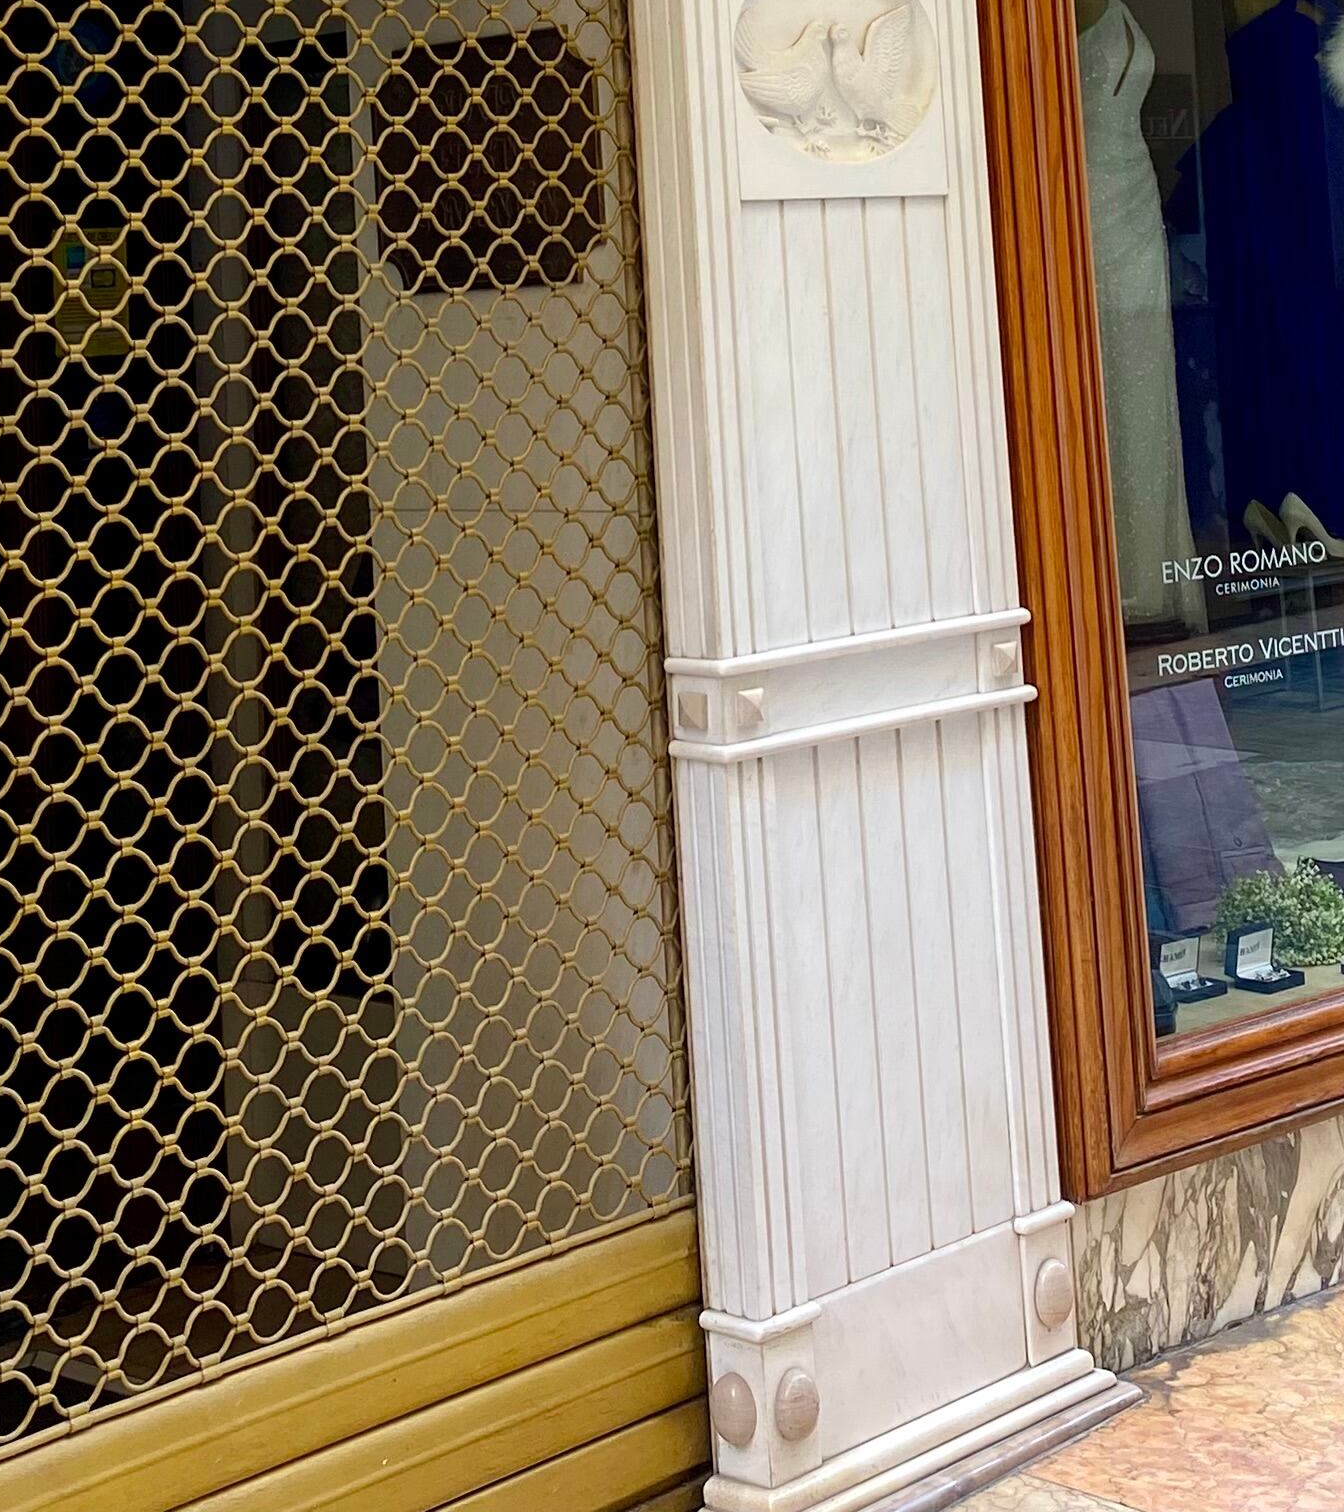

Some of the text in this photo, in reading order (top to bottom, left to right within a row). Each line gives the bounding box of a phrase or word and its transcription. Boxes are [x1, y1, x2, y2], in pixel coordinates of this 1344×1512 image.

[1161, 540, 1327, 584] ENZO ROMANO
[1215, 576, 1281, 596] CERIMONIA
[1157, 642, 1255, 677] ROBERTO
[1224, 668, 1284, 689] CERIMONIA
